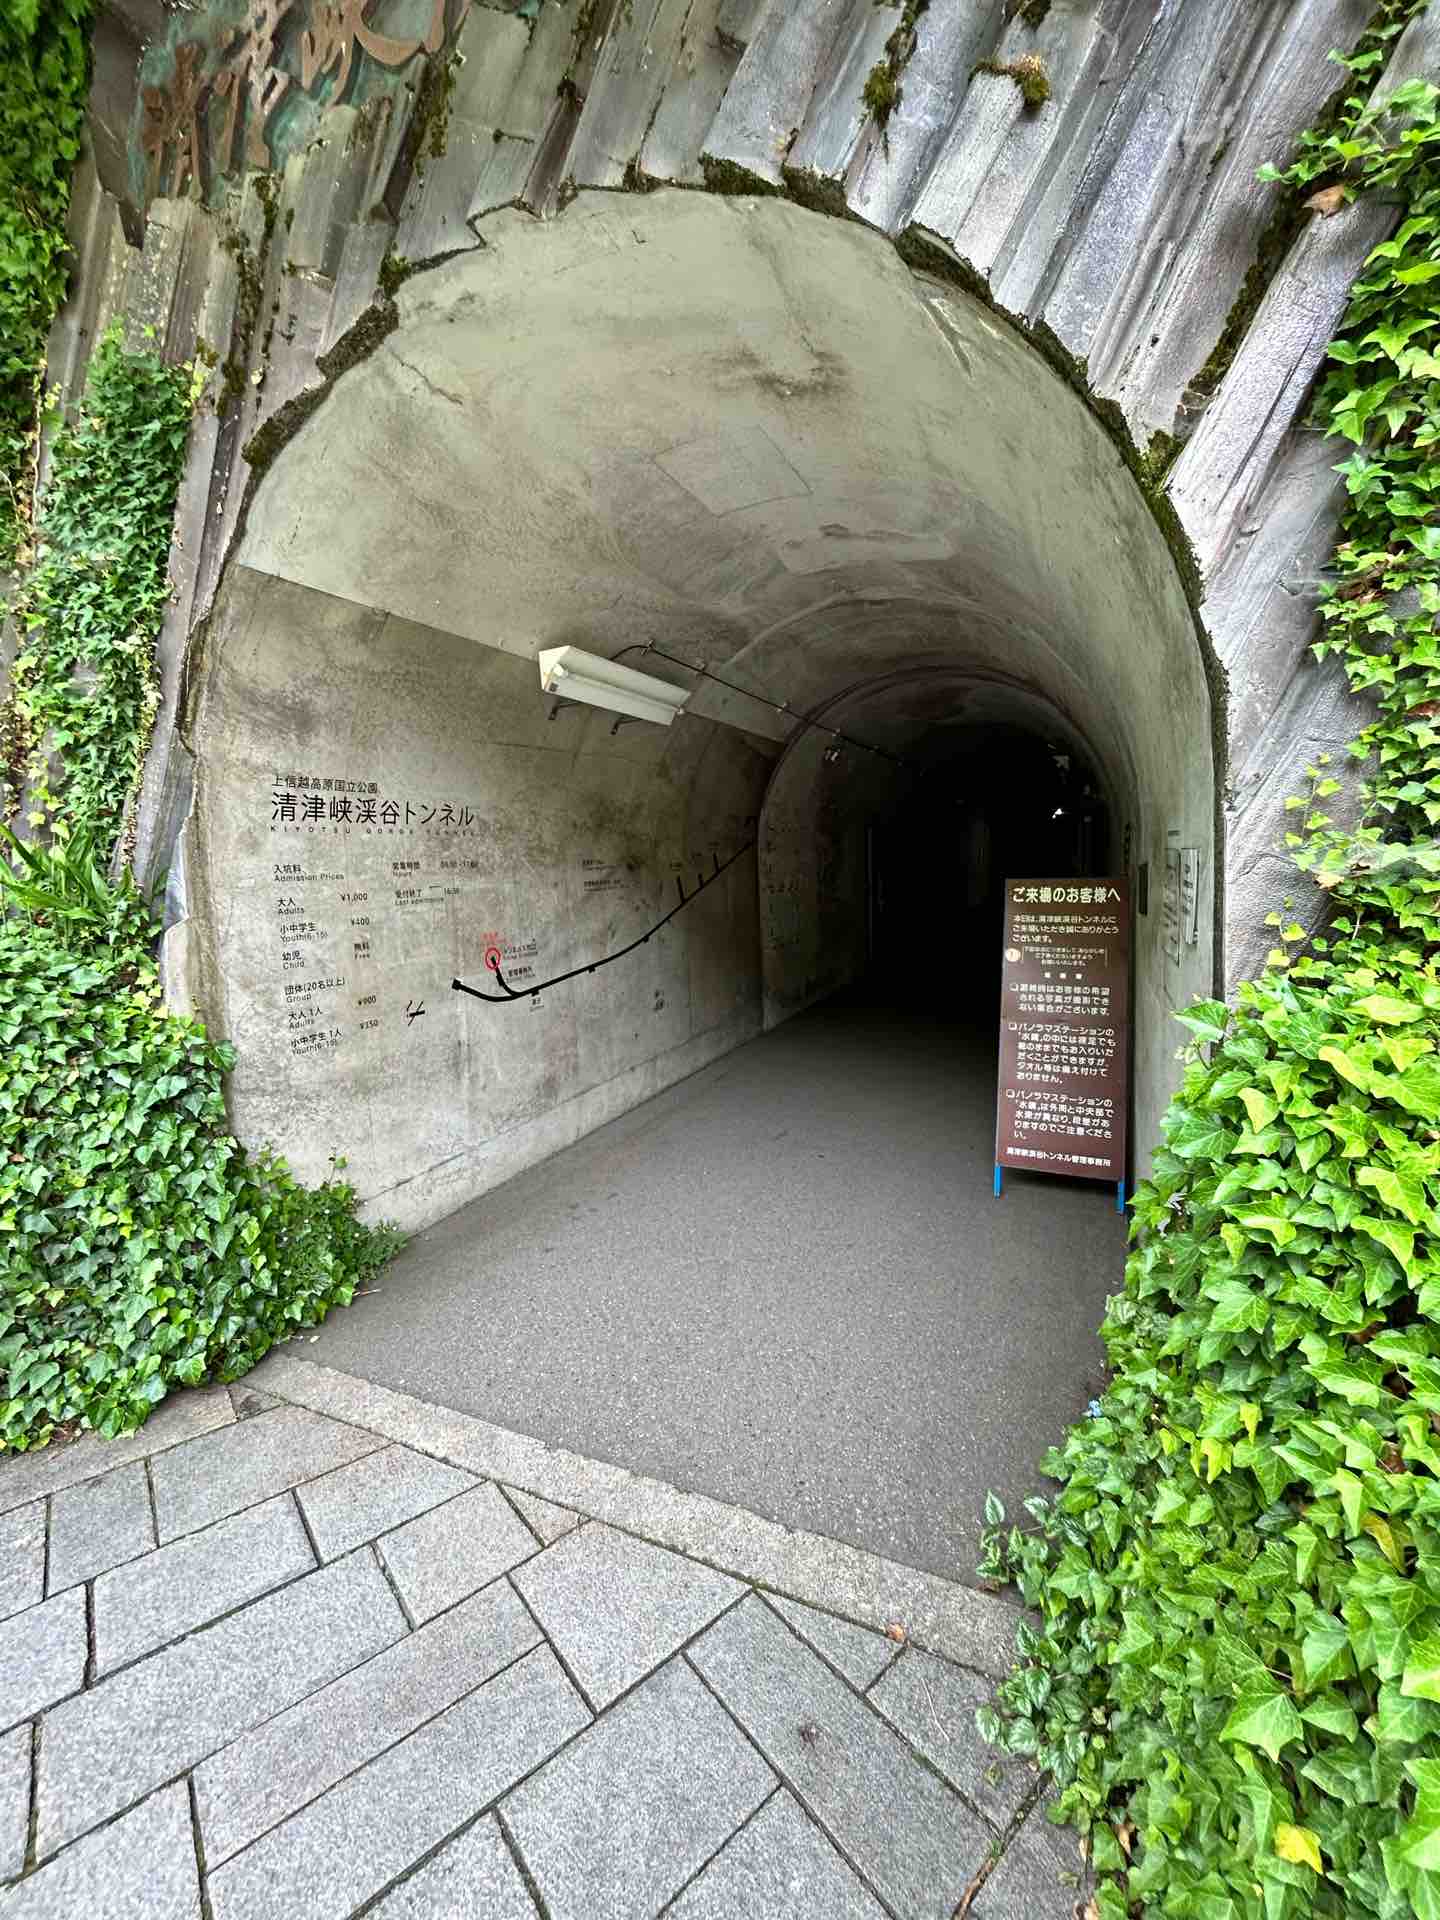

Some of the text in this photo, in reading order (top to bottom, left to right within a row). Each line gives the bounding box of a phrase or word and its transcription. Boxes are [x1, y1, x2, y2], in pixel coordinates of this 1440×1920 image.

[271, 775, 378, 794] 上信越高原国立公園
[271, 792, 475, 826] 清津峡渓谷トンネル
[270, 826, 351, 834] KIYOTSU
[274, 872, 345, 881] Admission Prices
[340, 893, 368, 902] ¥1,000
[1013, 886, 1120, 903] ご来場のお客様へ
[277, 897, 296, 907] 大人
[278, 907, 304, 915] Adults
[280, 922, 317, 934] 小中学生
[283, 961, 305, 970] Child
[286, 993, 311, 1003] Group
[1018, 1003, 1110, 1016] ない場合がございます。
[1018, 1023, 1115, 1037] パノラマステーションの
[1017, 1062, 1108, 1077] タオル等は備え付けて
[1016, 1090, 1113, 1107] パノラマステーションの
[1014, 1120, 1113, 1139] りますのでご注意くださ
[1006, 1146, 1112, 1167] 清津峡渓谷トンネル管理事務所
